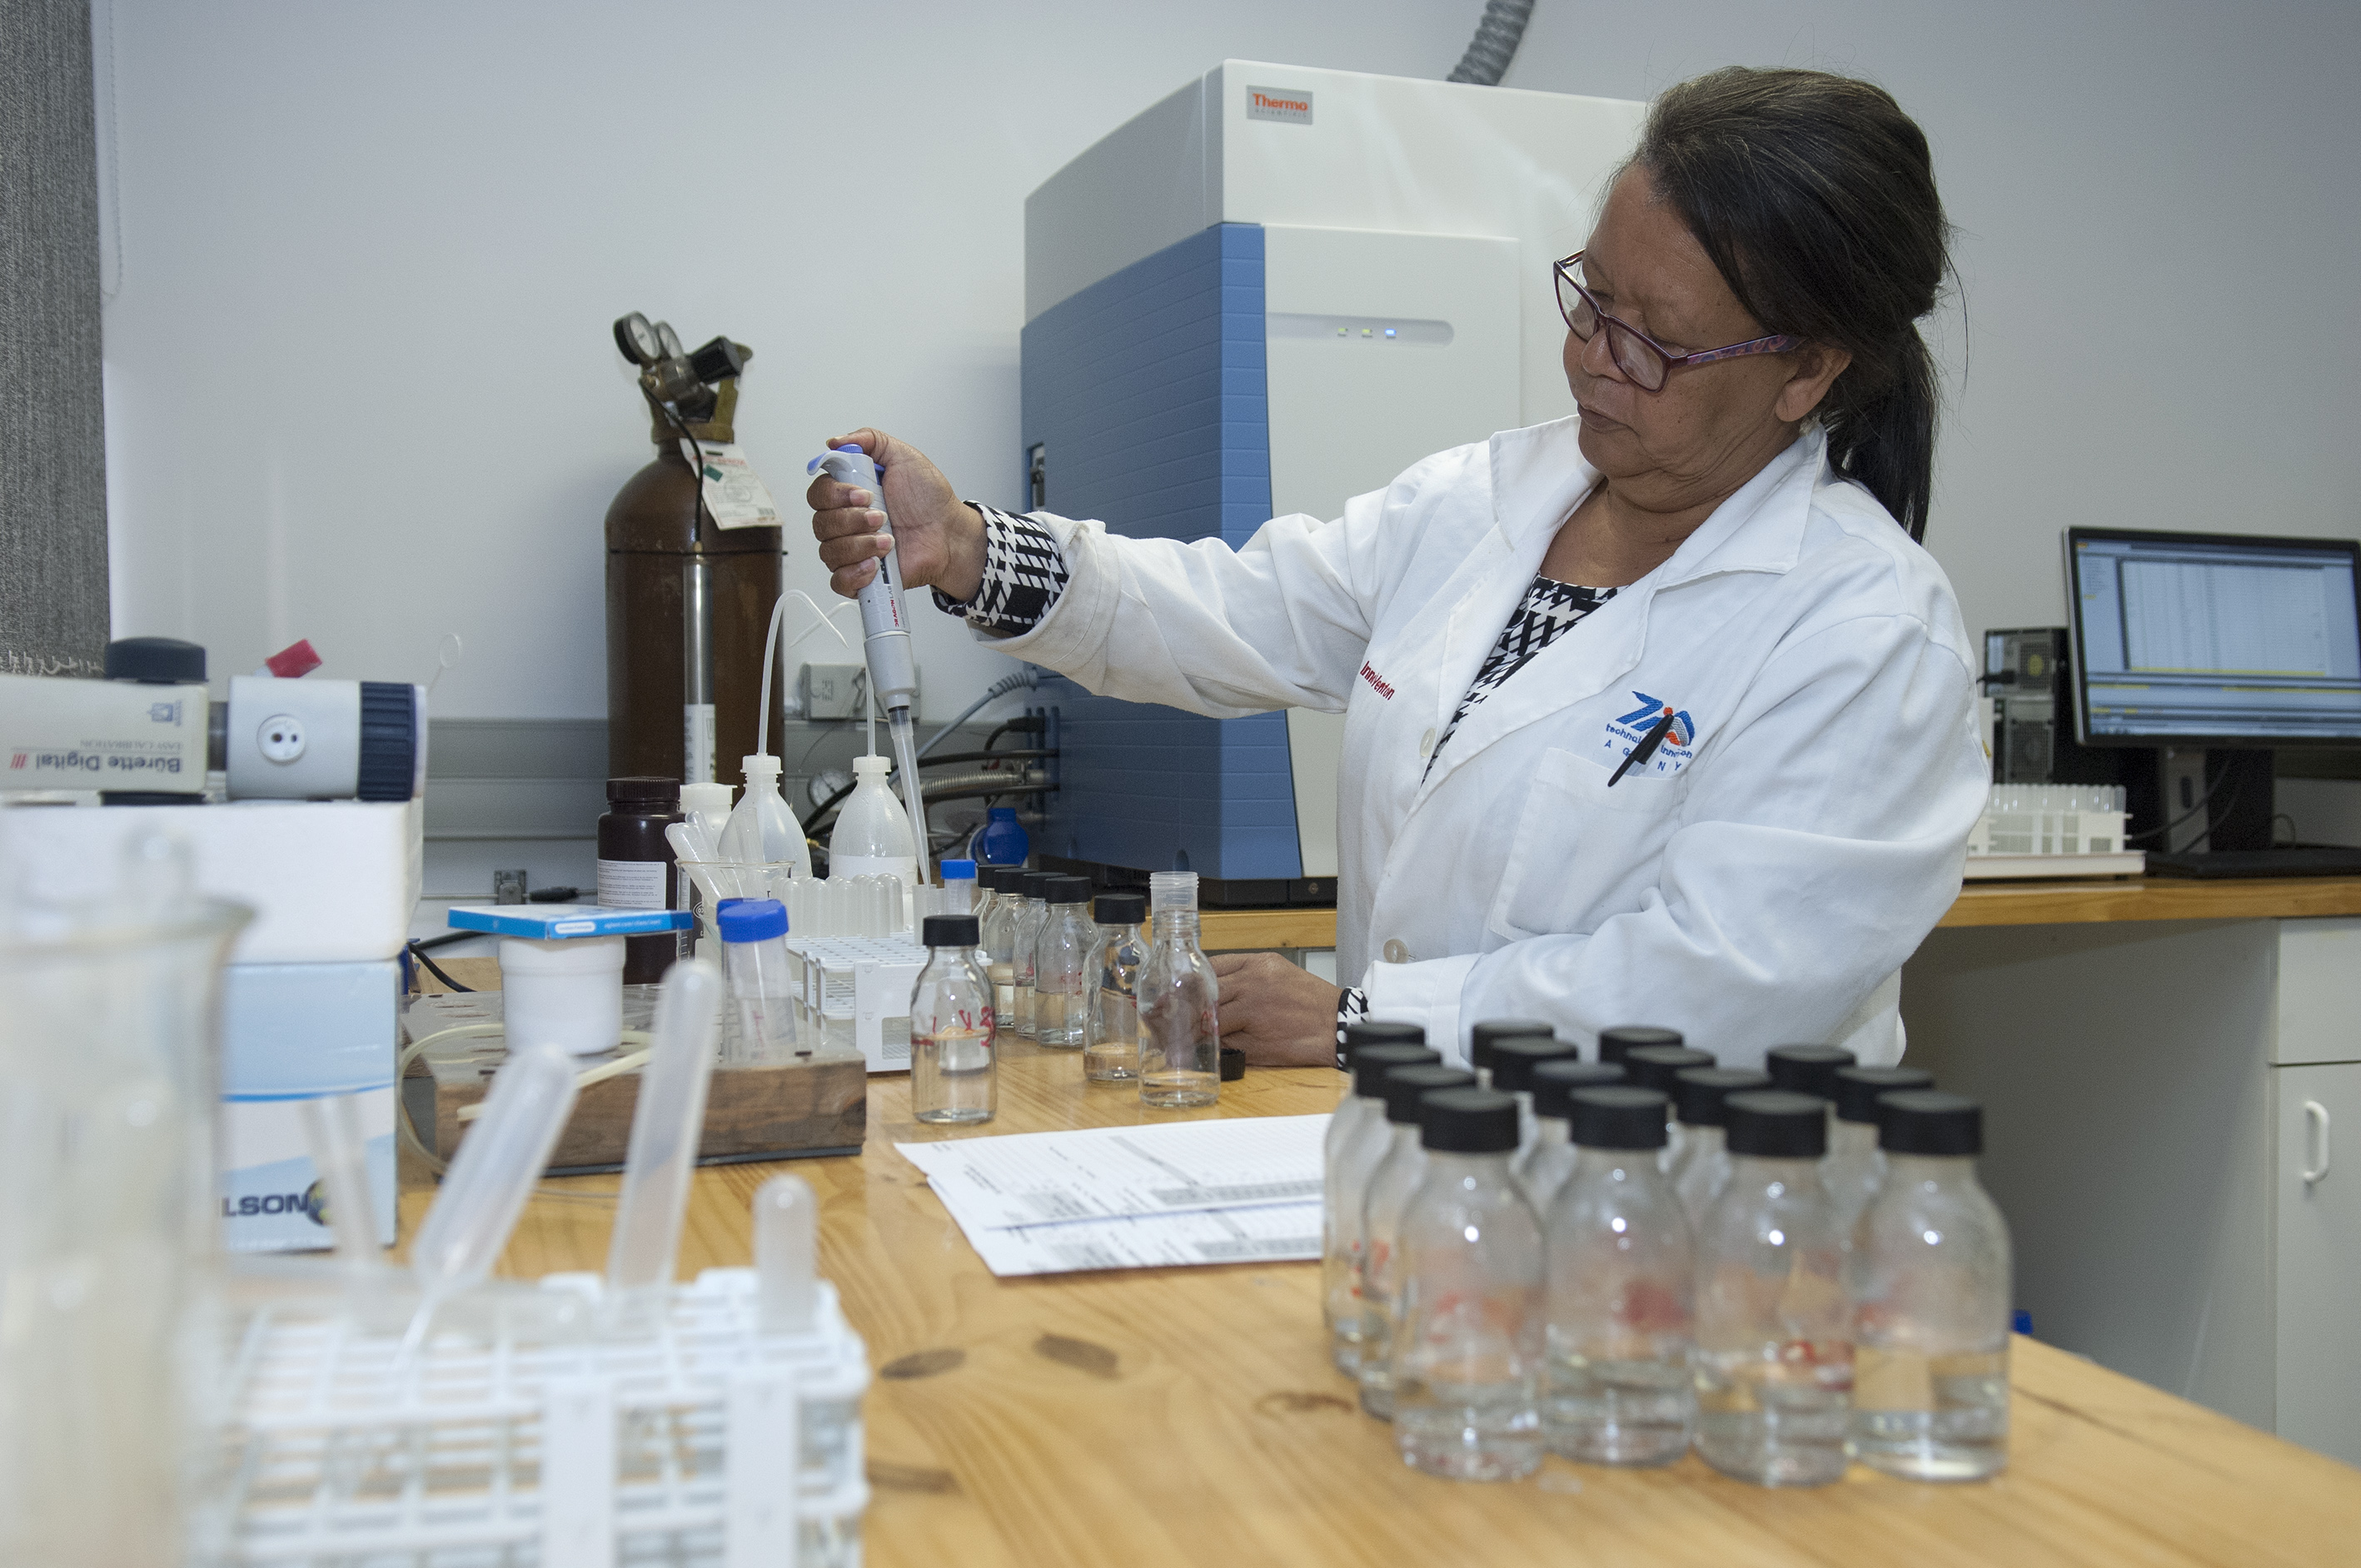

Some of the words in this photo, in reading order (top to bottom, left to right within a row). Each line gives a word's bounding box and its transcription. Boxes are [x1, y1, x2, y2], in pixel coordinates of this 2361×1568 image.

[1252, 92, 1308, 112] Thermo
[36, 750, 101, 771] Digital
[107, 755, 182, 773] Bürette
[221, 1193, 308, 1217] LSON
